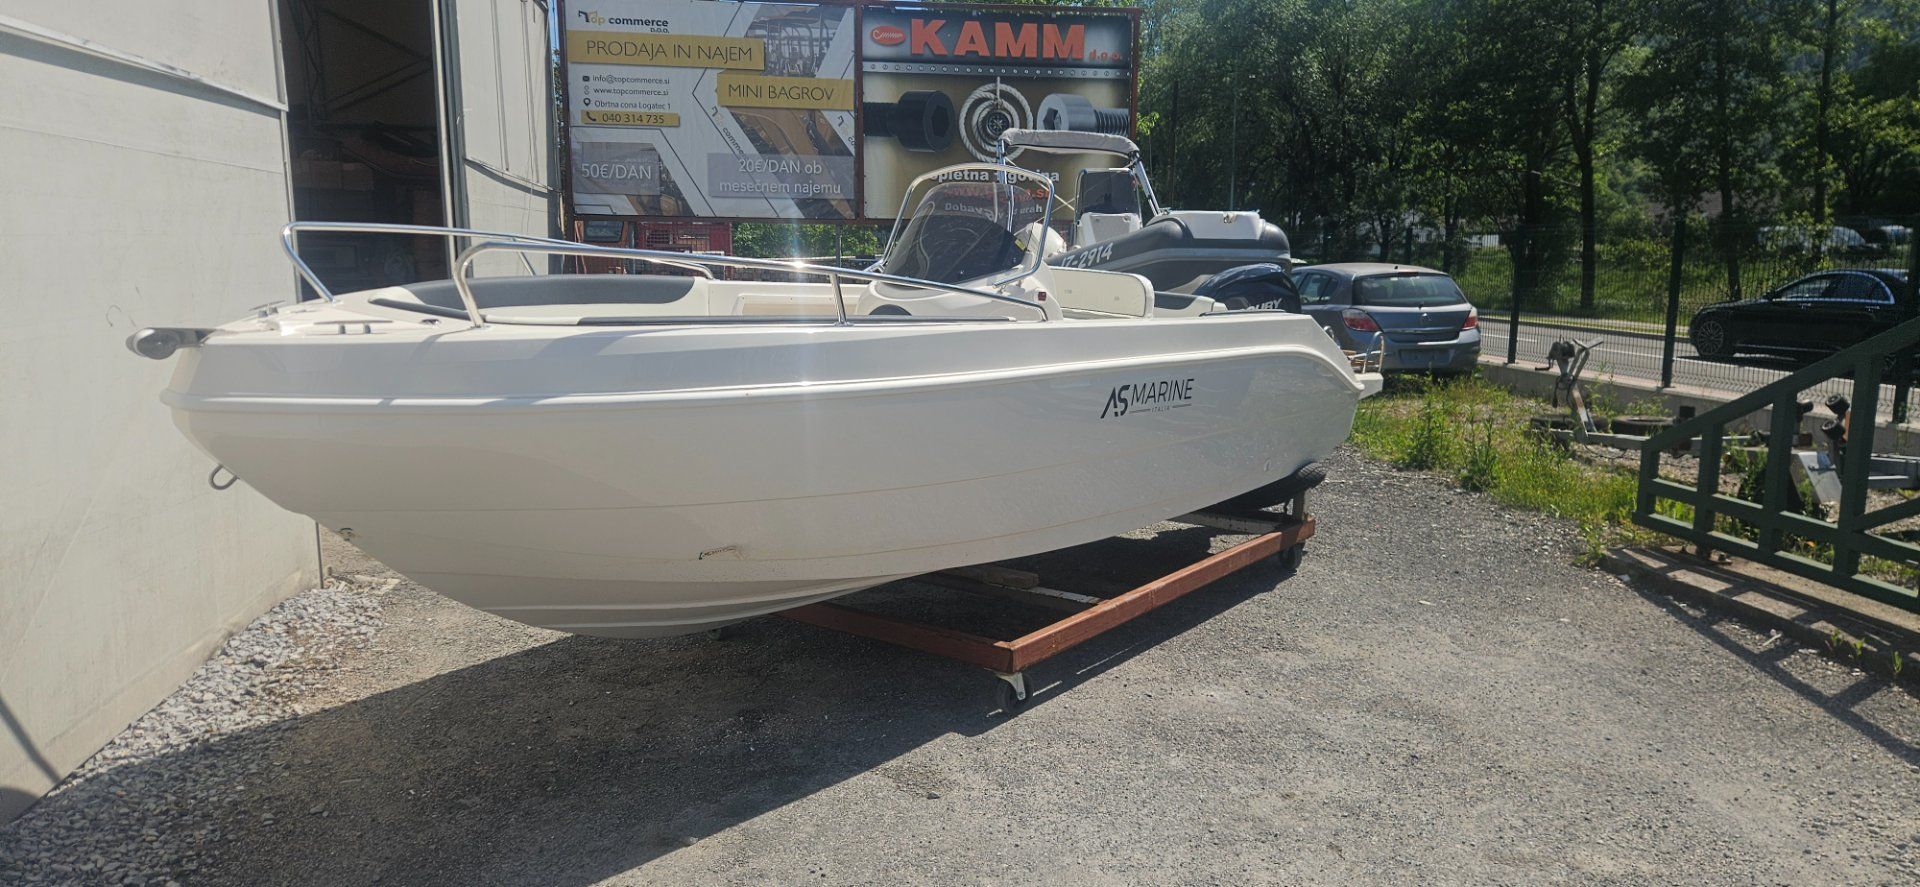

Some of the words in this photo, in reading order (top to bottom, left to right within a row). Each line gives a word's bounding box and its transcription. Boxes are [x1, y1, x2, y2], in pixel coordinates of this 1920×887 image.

[608, 15, 669, 27] commerce
[911, 18, 1085, 59] KAMM
[586, 40, 668, 61] PRODAJA
[673, 44, 691, 59] IN
[697, 46, 752, 65] NAJEM
[592, 75, 670, 85] info@topcommerce.si
[593, 87, 669, 97] www.topcommerce.si
[728, 84, 762, 98] MINI
[768, 85, 834, 101] BAGROV
[594, 100, 619, 109] Obrtna
[638, 102, 666, 110] Logatec
[602, 113, 621, 123] 040
[624, 114, 643, 124] 314
[646, 114, 665, 124] 735
[581, 163, 651, 180] 50€/DAN
[738, 158, 800, 174] 20€/DAN
[804, 160, 822, 175] ob
[794, 183, 841, 197] najemu
[1131, 378, 1195, 406] MARINE
